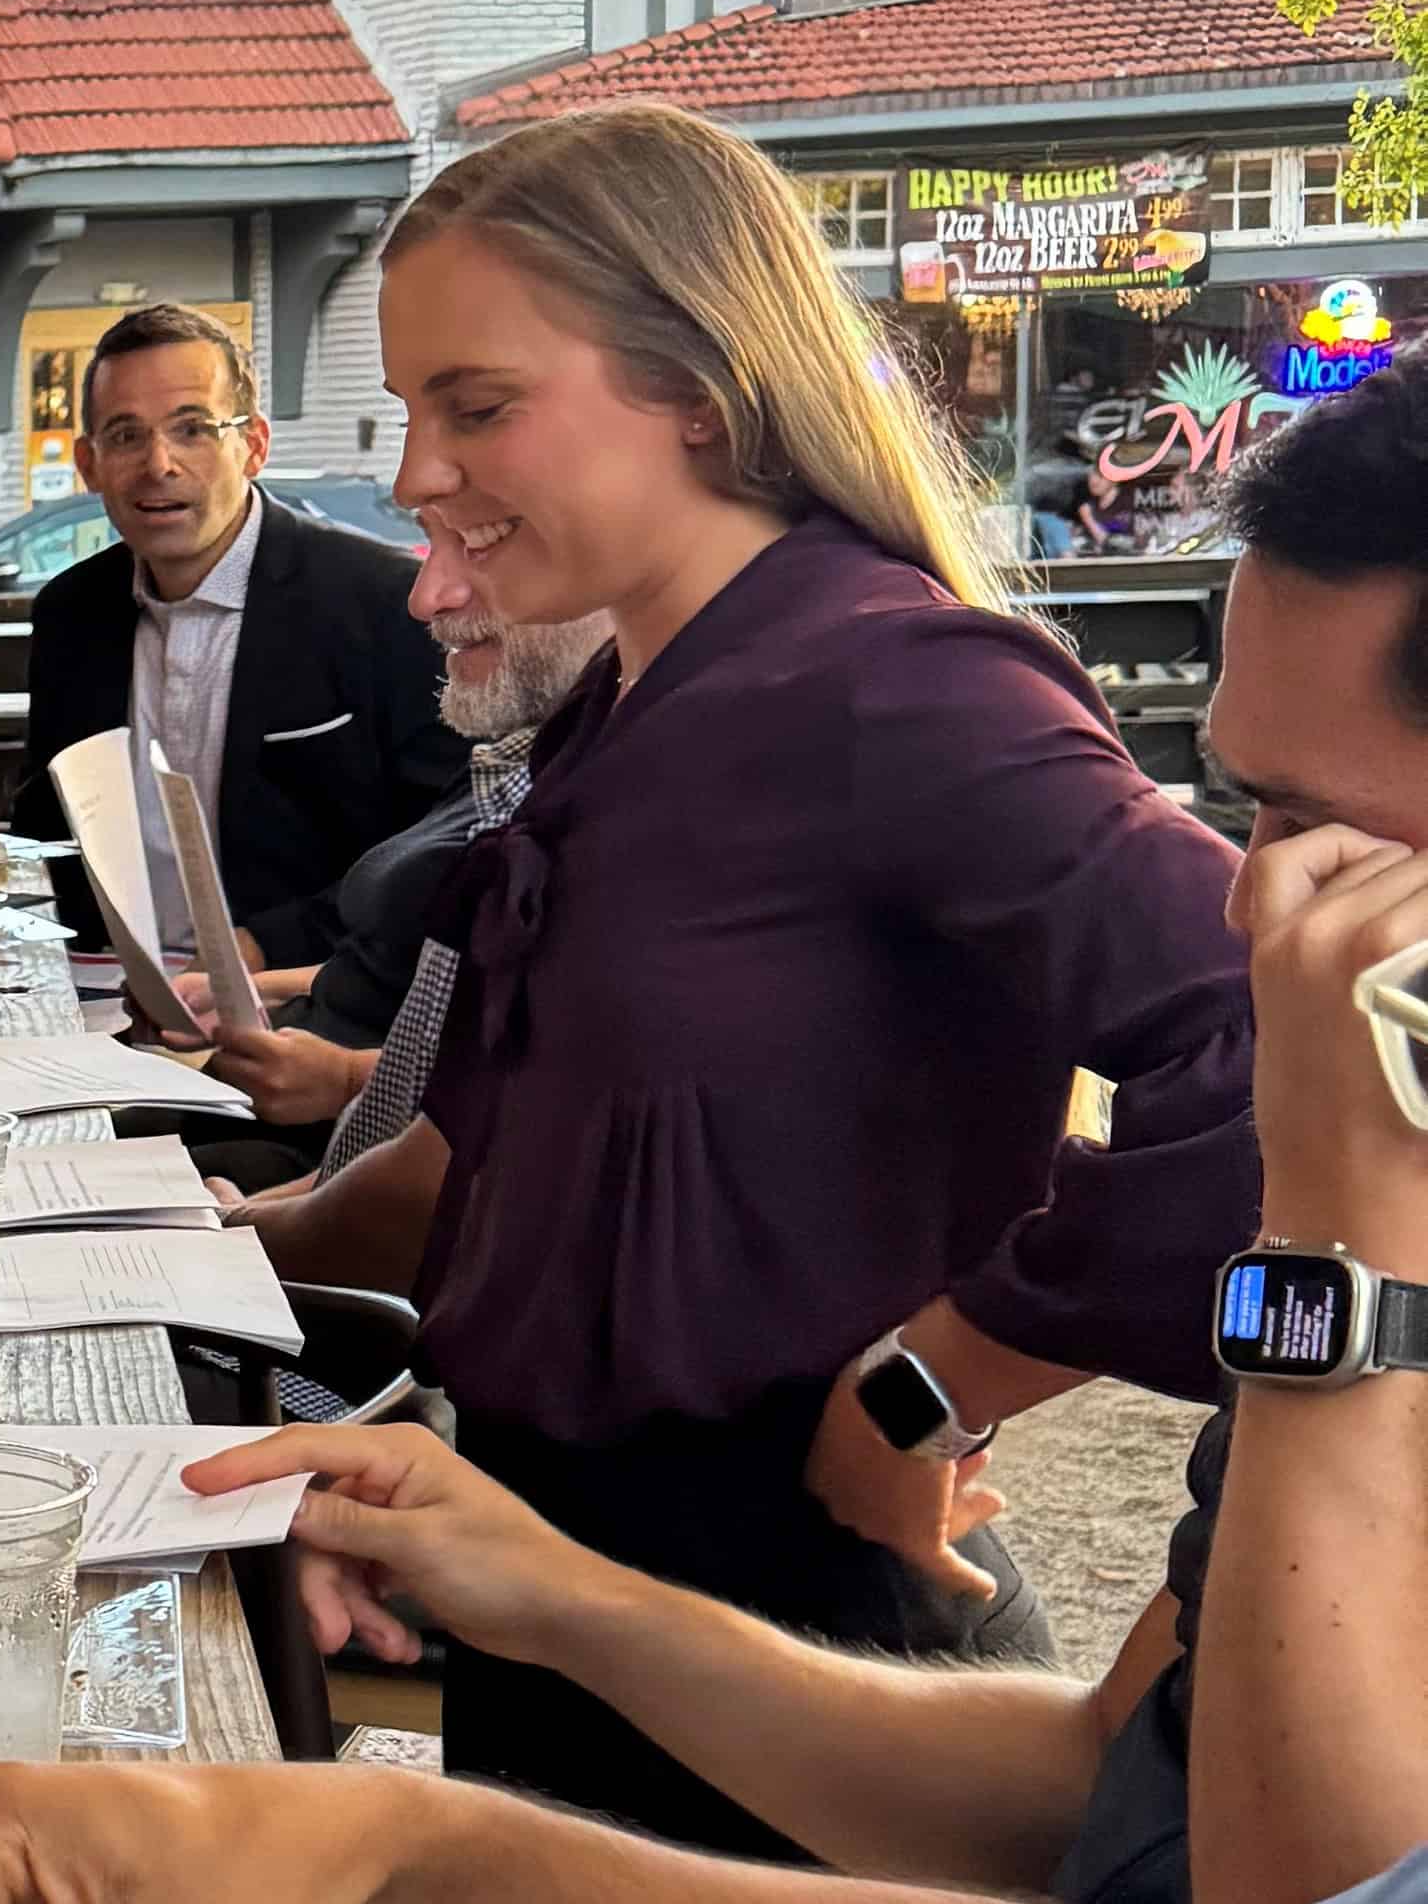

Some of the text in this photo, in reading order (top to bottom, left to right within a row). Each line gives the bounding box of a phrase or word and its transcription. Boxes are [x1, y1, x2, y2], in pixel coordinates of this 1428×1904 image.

[909, 168, 1009, 209] HAPPY
[1022, 166, 1117, 202] HOUR!
[992, 199, 1138, 240] MARGARITA
[1030, 231, 1097, 271] BEER
